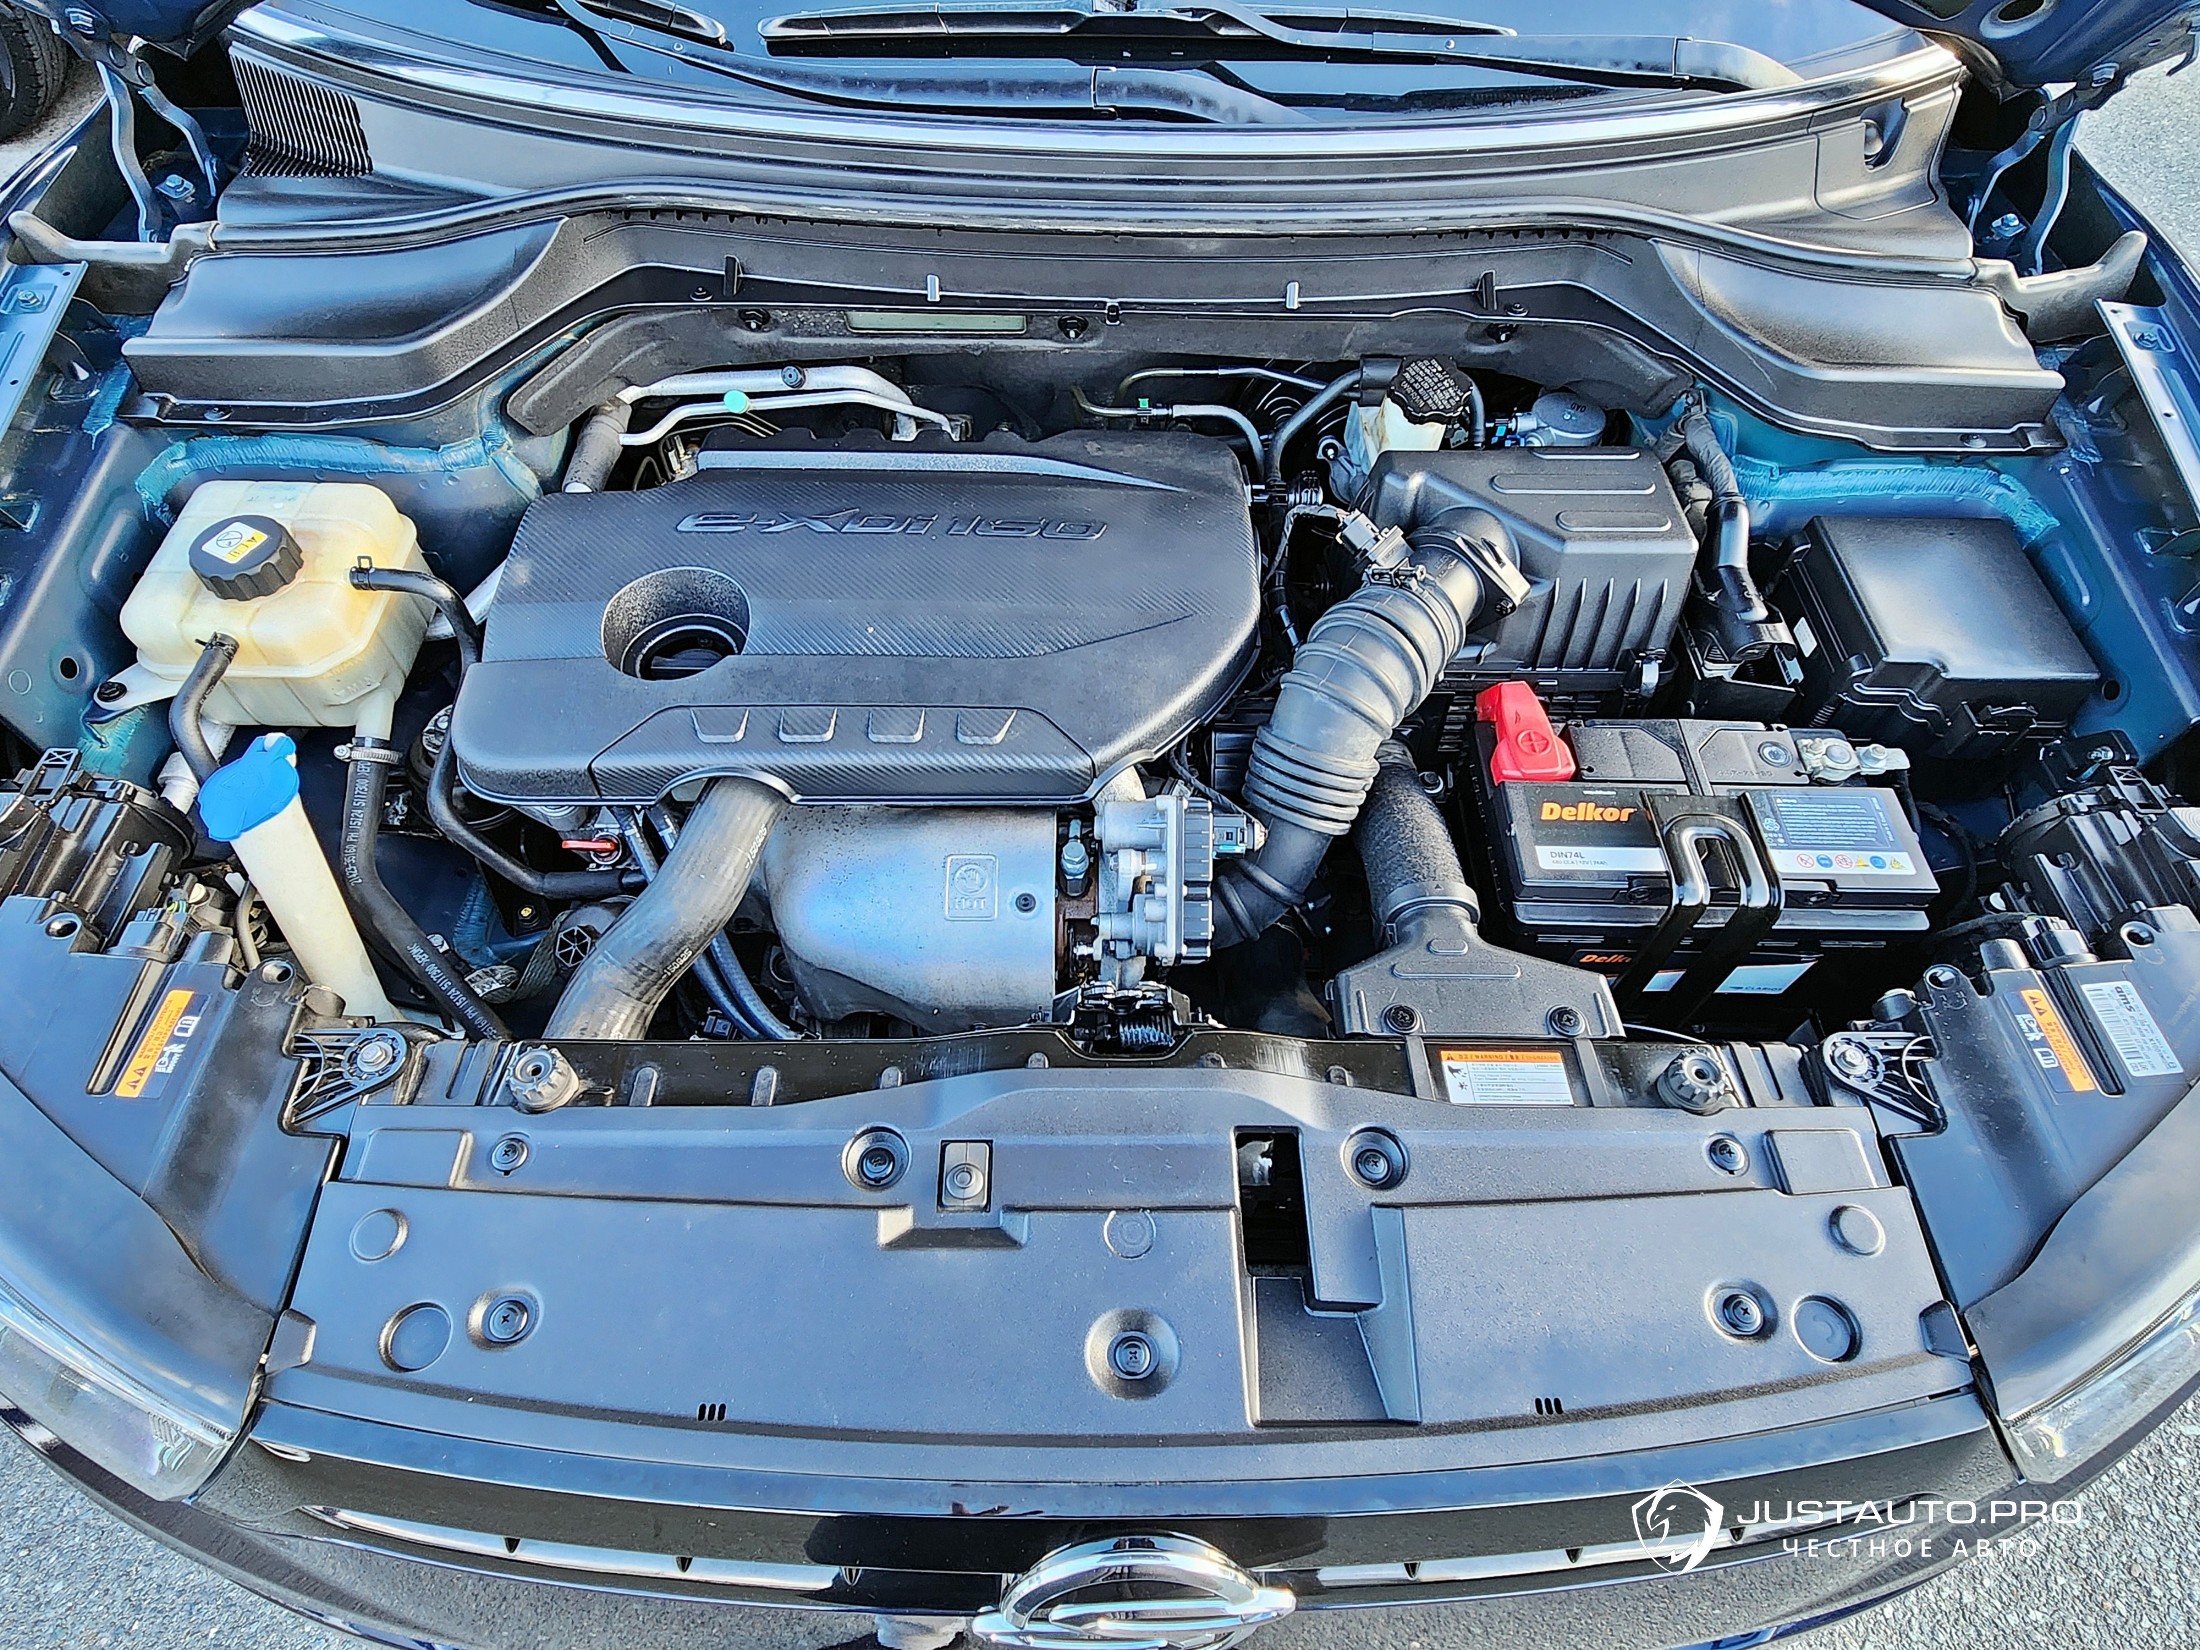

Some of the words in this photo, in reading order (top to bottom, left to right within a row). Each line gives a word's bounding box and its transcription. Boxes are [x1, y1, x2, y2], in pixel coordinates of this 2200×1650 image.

[1541, 802, 1636, 822] Delkor
[1550, 851, 1585, 859] DIN74L
[954, 897, 986, 911] HOT
[2114, 985, 2136, 1013] ams
